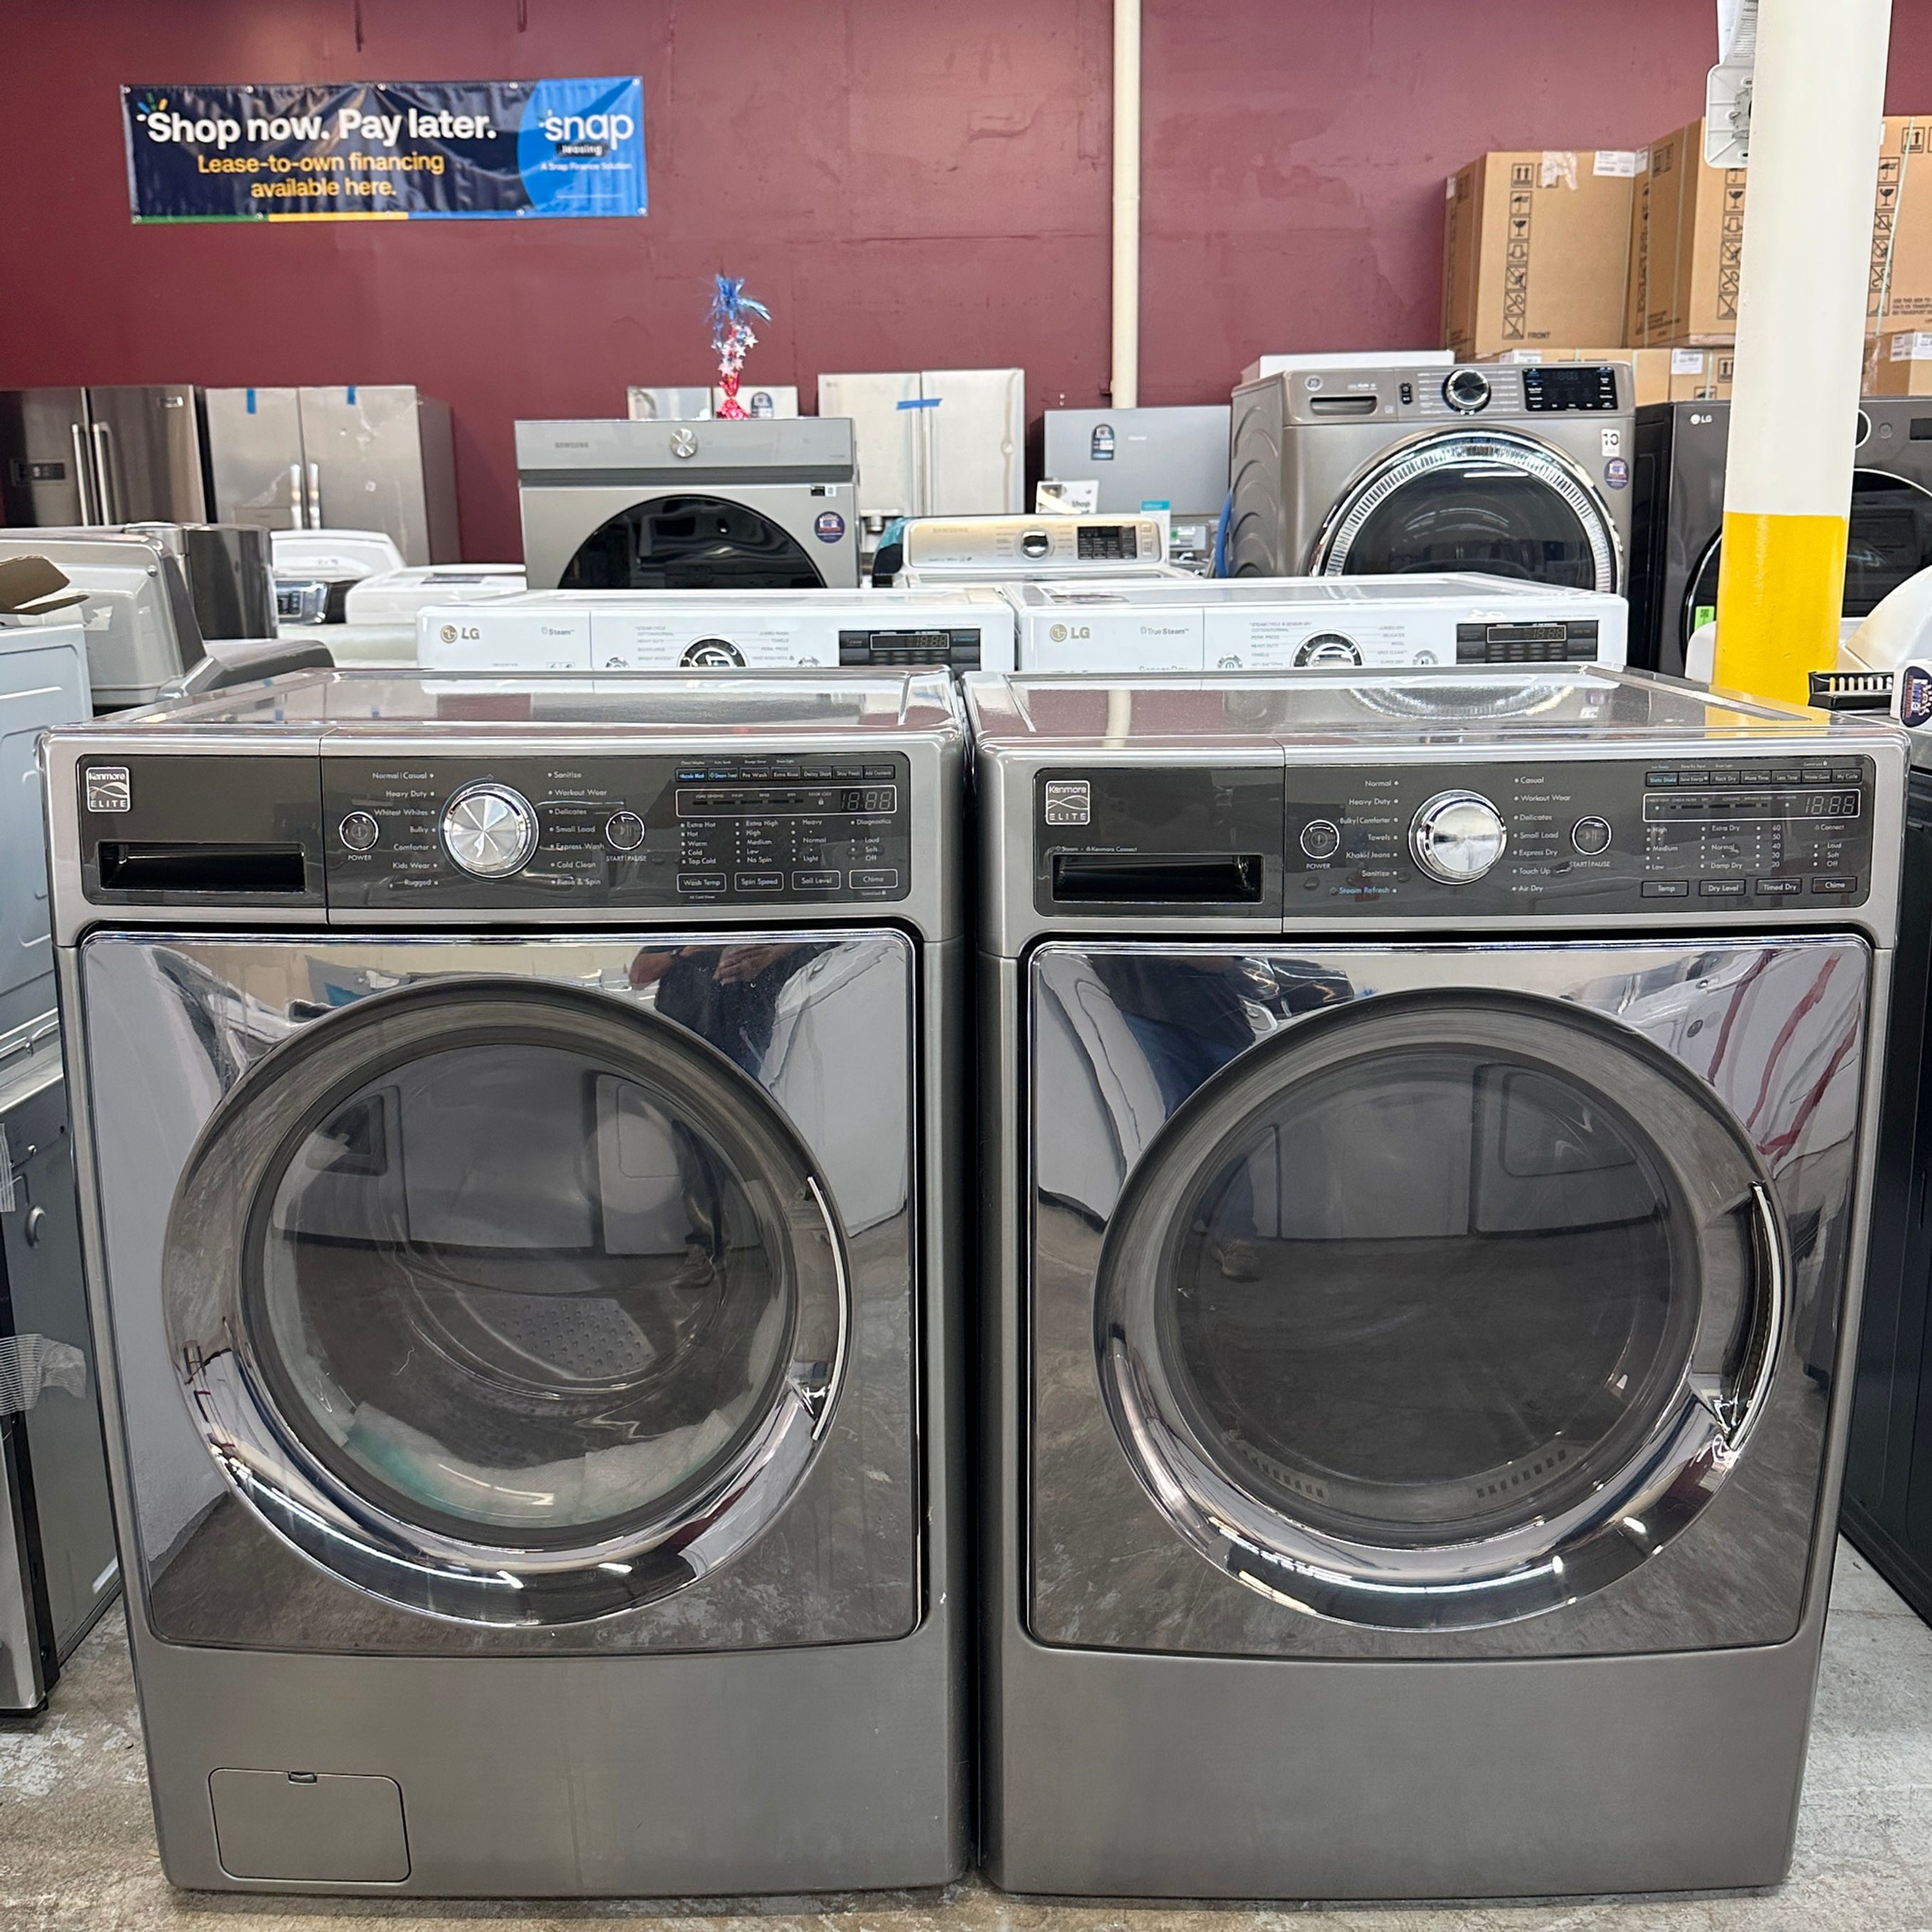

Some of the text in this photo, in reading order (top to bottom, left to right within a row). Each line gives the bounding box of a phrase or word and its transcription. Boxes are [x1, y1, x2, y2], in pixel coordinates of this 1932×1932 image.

[147, 108, 497, 150] Shop now. Pay later.
[544, 114, 635, 151] snap
[197, 152, 445, 175] Lease-to-own financing
[251, 177, 397, 197] available here.
[1701, 414, 1713, 424] LG
[461, 627, 480, 640] LG
[1070, 627, 1090, 639] LG
[385, 790, 427, 798] Heavy Duty
[409, 825, 428, 834] Bulky
[555, 842, 582, 851] Express
[1518, 849, 1544, 857] Express
[404, 878, 432, 887] Rugged
[585, 878, 601, 887] Spin
